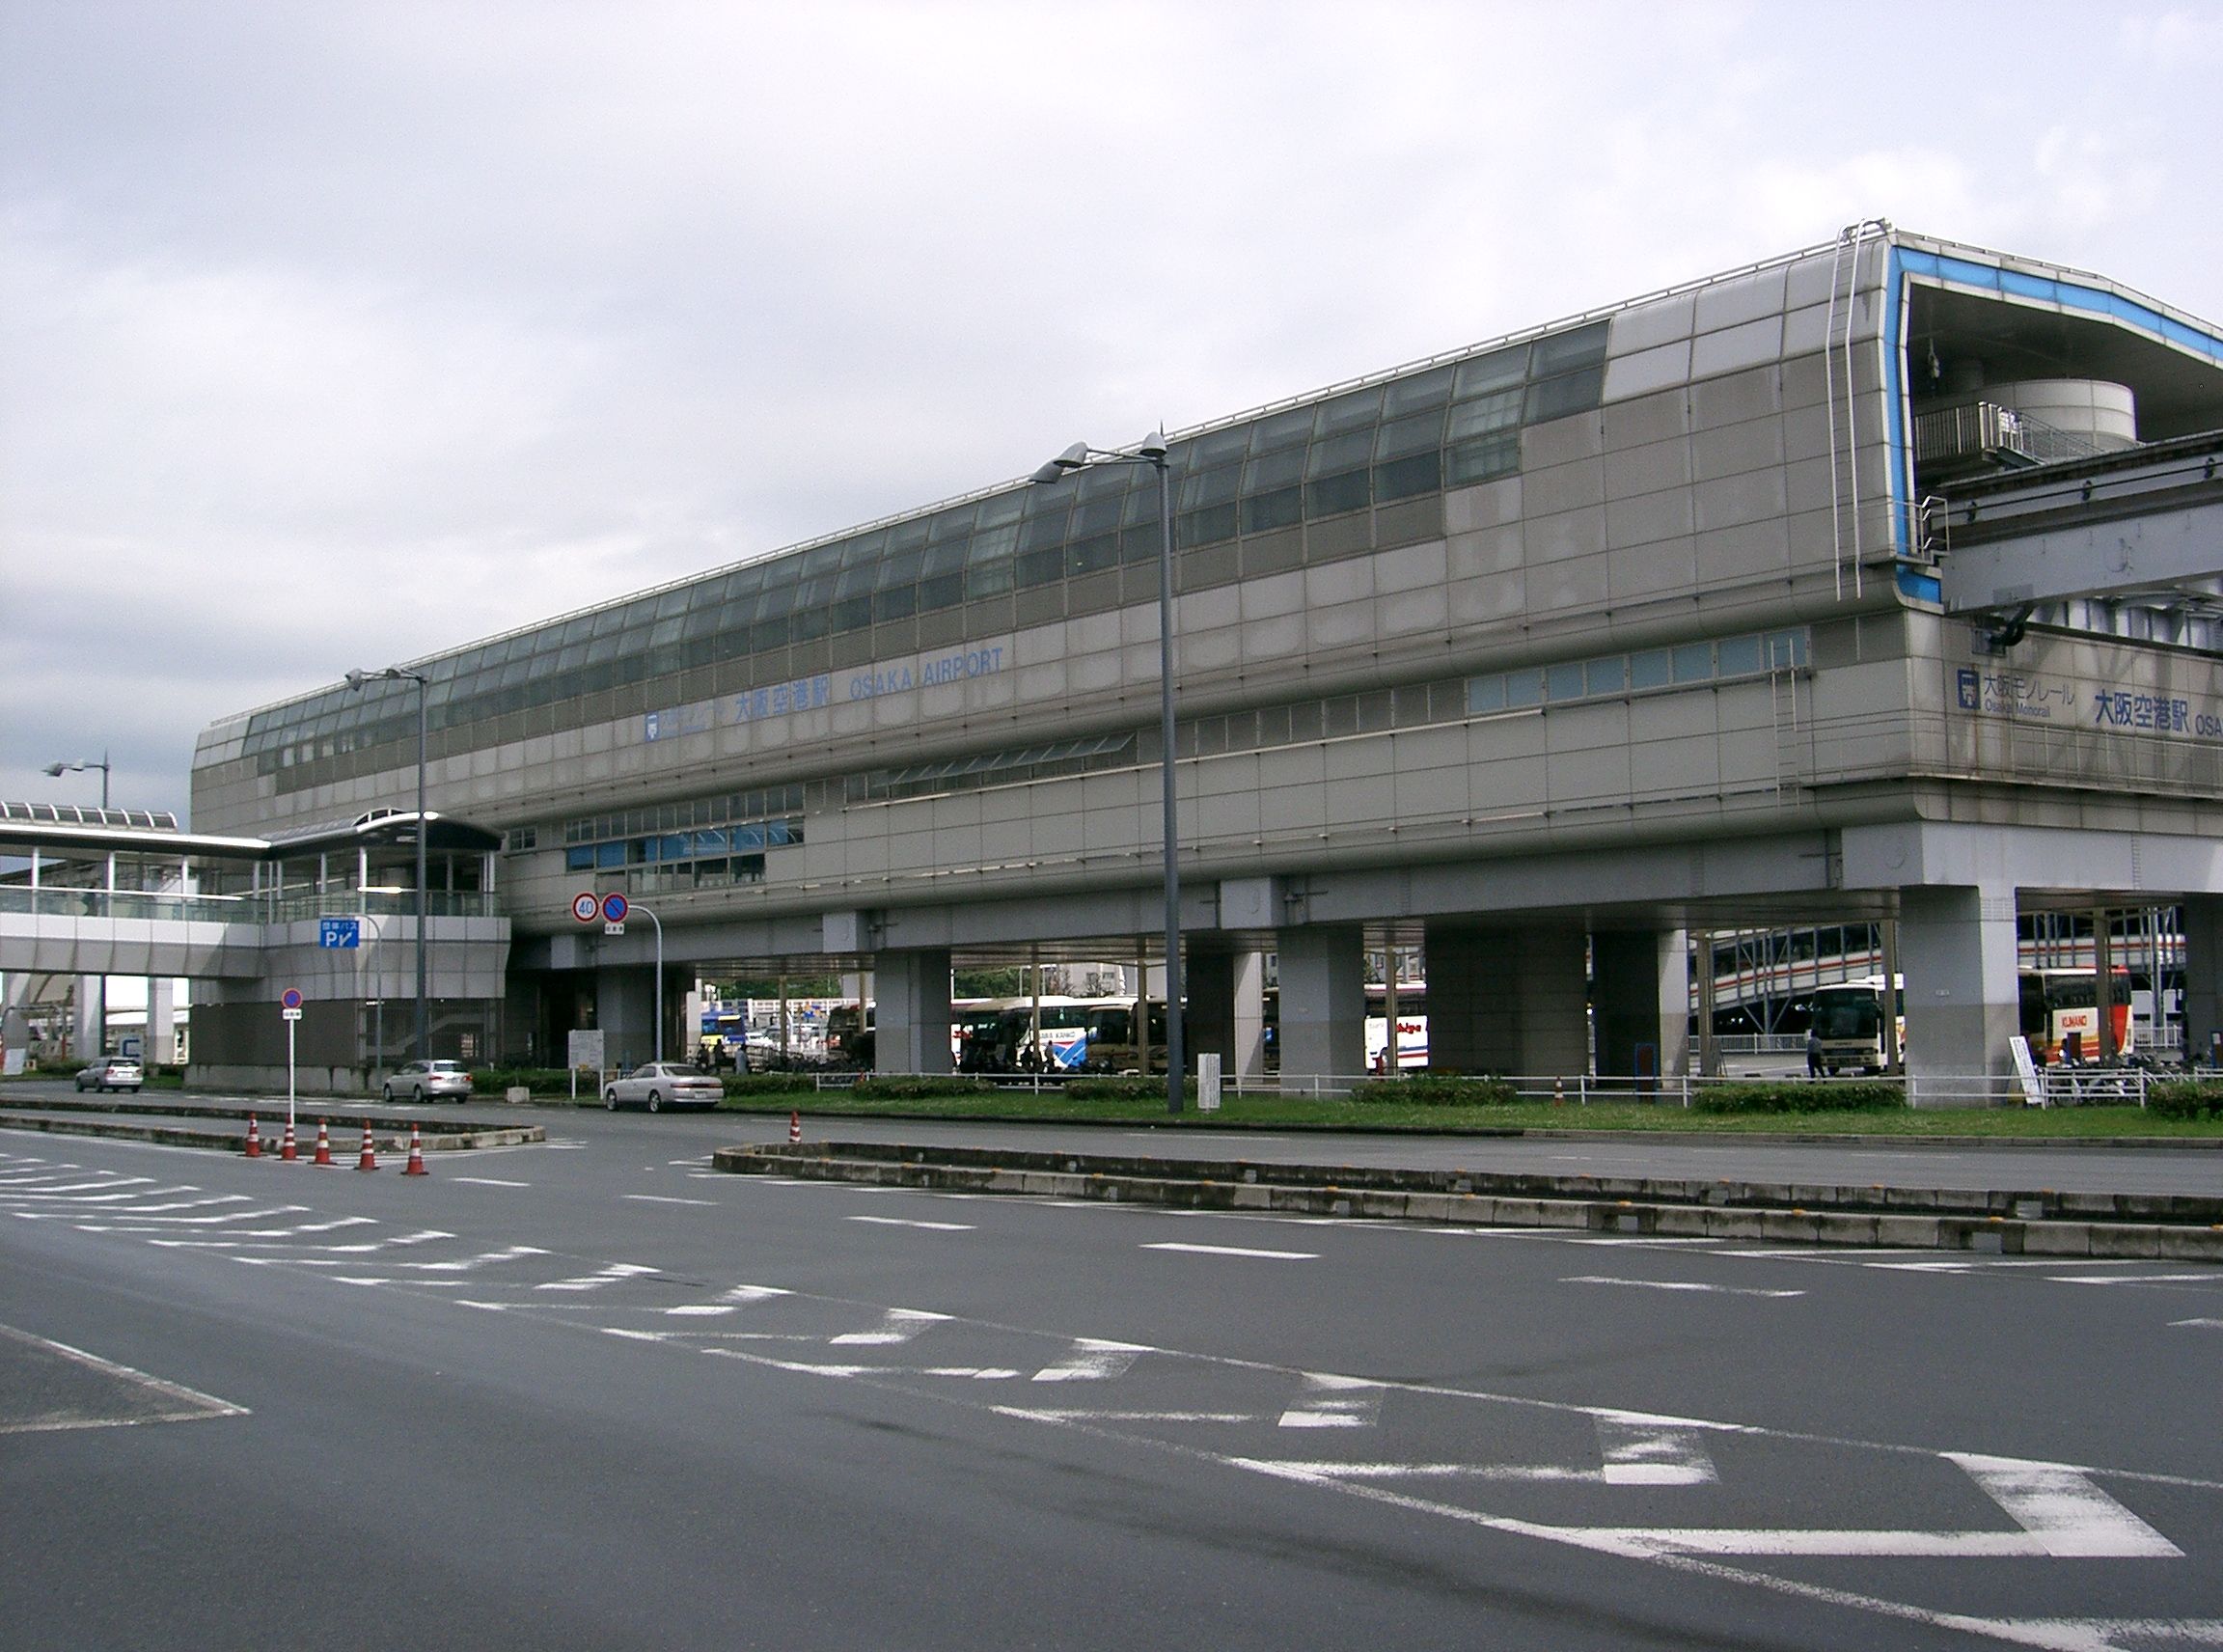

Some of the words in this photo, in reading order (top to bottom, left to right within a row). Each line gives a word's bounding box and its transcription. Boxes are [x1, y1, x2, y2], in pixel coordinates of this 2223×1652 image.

[849, 667, 912, 701] OSAKA
[923, 647, 1003, 686] AIRPORT
[1984, 673, 2075, 705] 大阪モノレール
[1985, 698, 2013, 715] Osaka
[2016, 702, 2050, 718] Monorail
[2095, 688, 2190, 733] 大阪空港駅
[579, 900, 593, 914] 40
[326, 931, 338, 947] P
